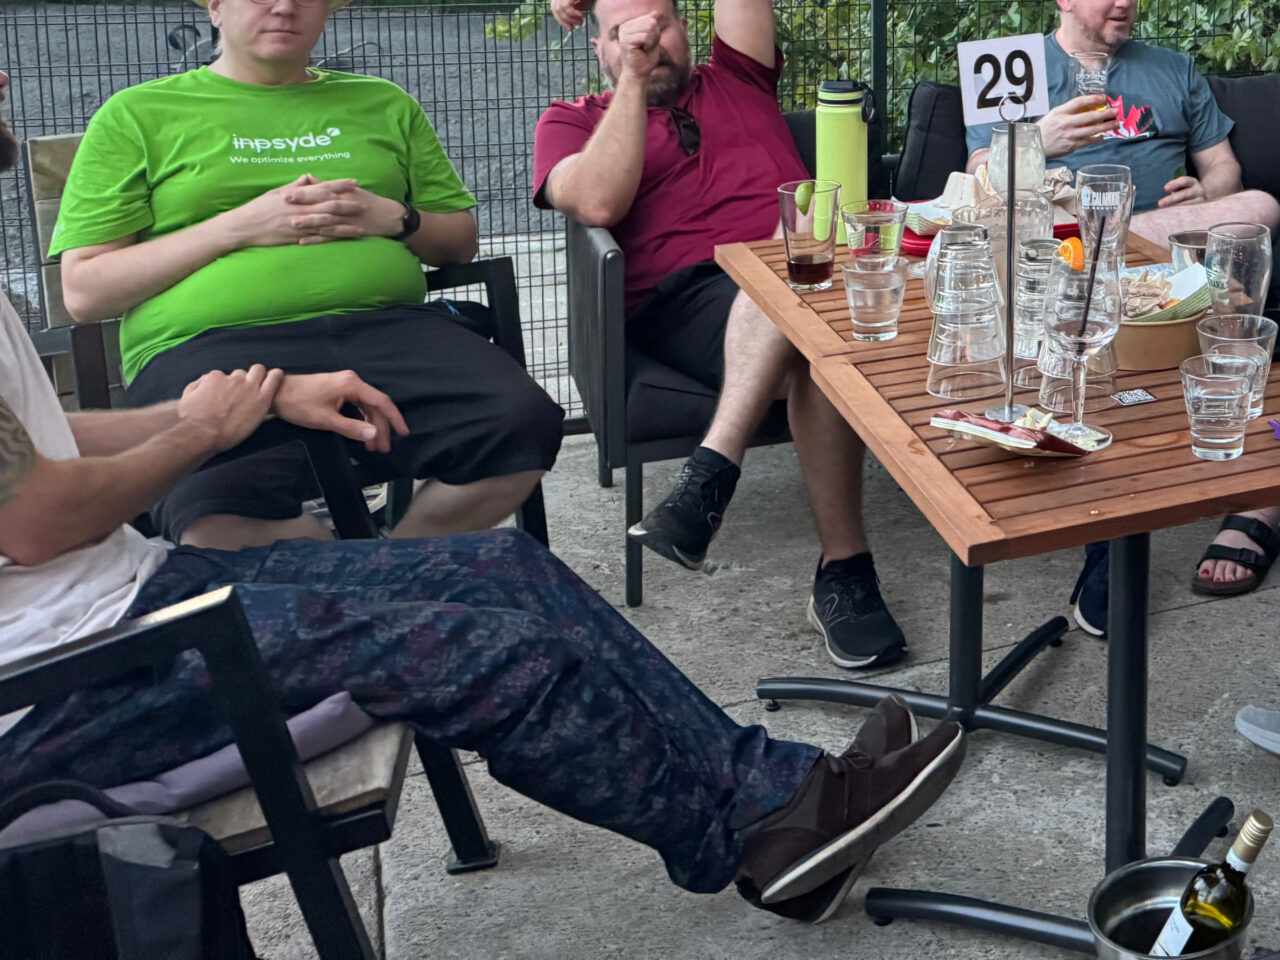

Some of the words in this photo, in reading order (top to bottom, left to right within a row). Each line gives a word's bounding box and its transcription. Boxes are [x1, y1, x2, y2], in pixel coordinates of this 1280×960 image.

[973, 49, 1034, 110] 29
[232, 132, 332, 153] inpsyde
[229, 156, 249, 164] We
[250, 155, 295, 165] optimize
[296, 151, 351, 163] everything
